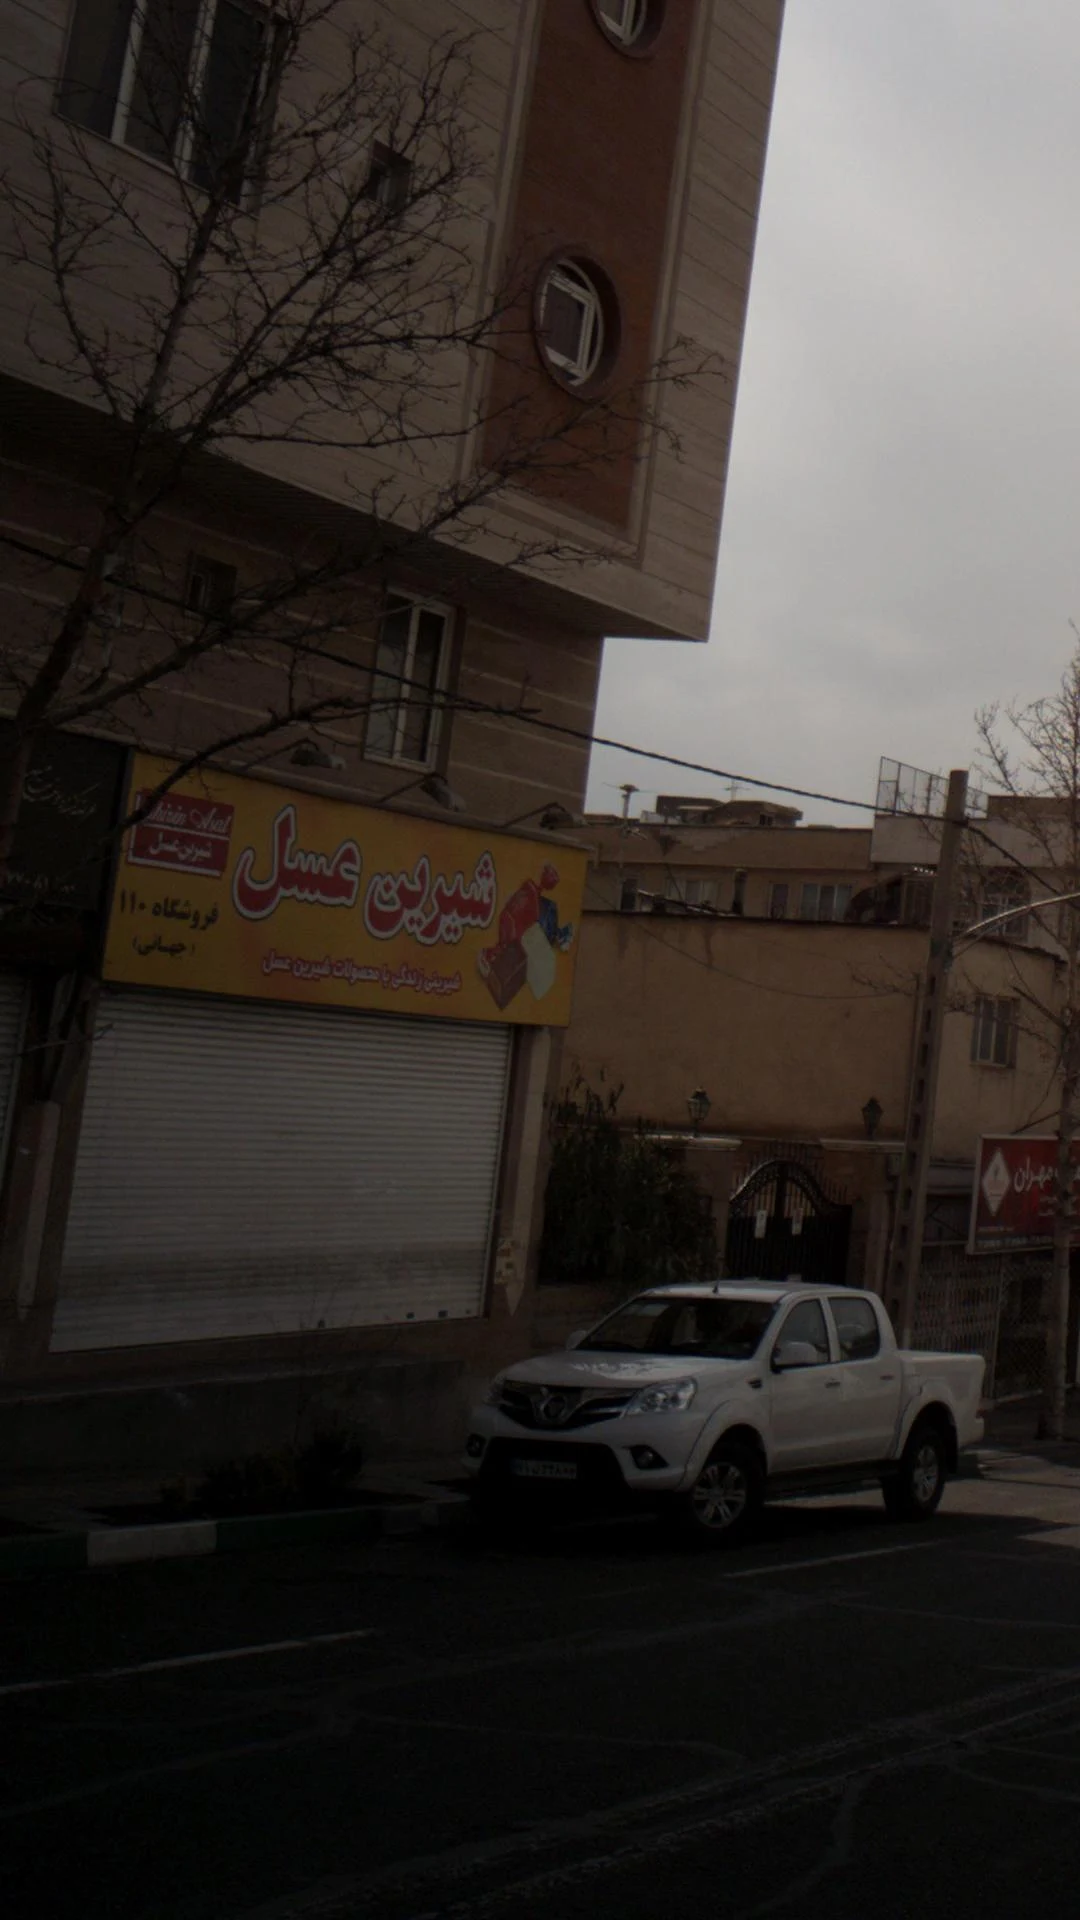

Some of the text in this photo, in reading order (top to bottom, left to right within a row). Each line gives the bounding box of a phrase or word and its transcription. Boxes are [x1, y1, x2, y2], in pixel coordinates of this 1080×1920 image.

[148, 832, 213, 863] شیرین عسل
[233, 804, 497, 946] شیرین عسل
[119, 888, 219, 931] فروشگاه ۱۱۰
[262, 948, 463, 996] شیرینی زندگی با محصولات شیرین عسل
